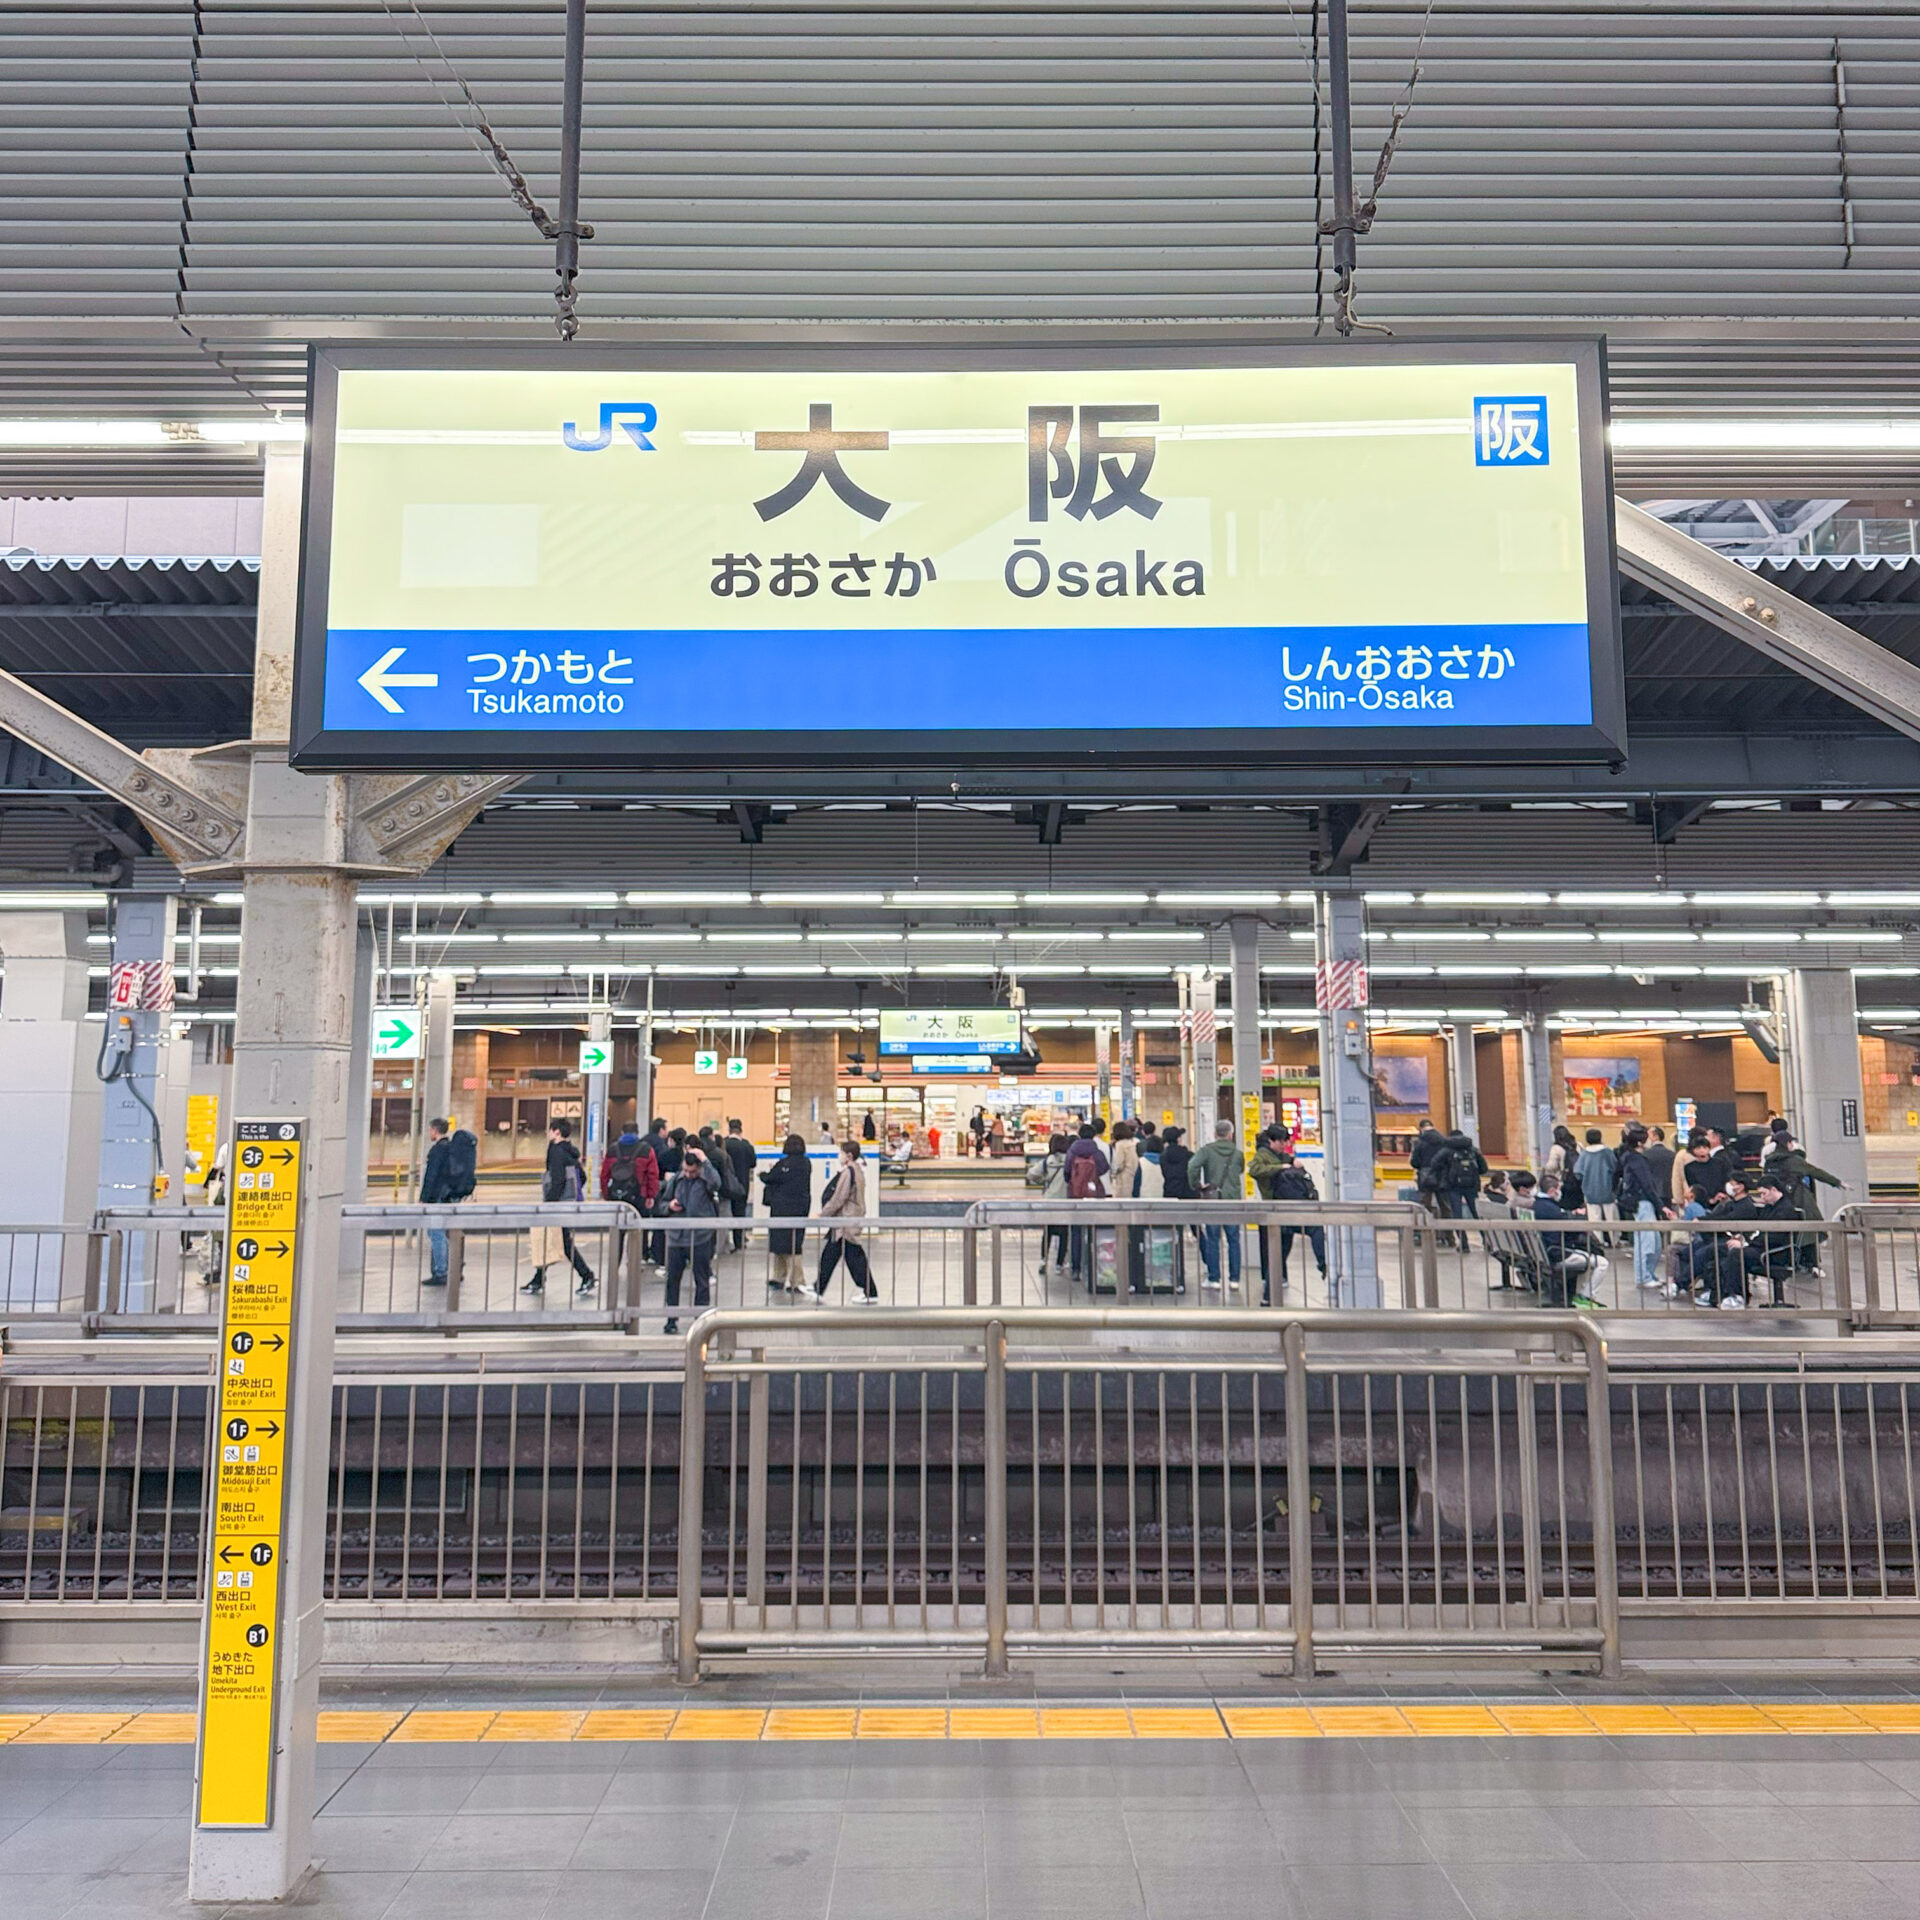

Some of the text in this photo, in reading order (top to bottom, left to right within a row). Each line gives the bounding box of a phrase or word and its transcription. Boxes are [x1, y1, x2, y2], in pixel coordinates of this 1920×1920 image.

[563, 401, 658, 451] JR
[1481, 402, 1543, 461] 阪
[710, 539, 1206, 598] おおさか Ōsaka
[466, 650, 635, 686] つかもと
[1282, 645, 1516, 681] しんおおさか
[1283, 679, 1454, 711] Shin-Ōsaka
[466, 690, 624, 715] Tsukamoto
[241, 1125, 268, 1133] ここは
[281, 1127, 293, 1137] 2F
[244, 1150, 262, 1165] 3F
[238, 1192, 292, 1202] 連絡橋出口
[237, 1203, 265, 1212] Bridge
[240, 1242, 257, 1257] 1F
[232, 1284, 278, 1294] 桜橋出口
[231, 1296, 288, 1304] Sakurabashi Exit
[234, 1336, 252, 1350] 1F
[227, 1378, 273, 1388] 中央出口
[226, 1390, 276, 1398] Central Exit
[230, 1422, 247, 1437] 1F
[223, 1465, 278, 1476] 御堂筋出口
[256, 1477, 271, 1485] Exit
[221, 1502, 255, 1512] 南出口
[220, 1514, 264, 1522] South Exit
[253, 1547, 271, 1561] 1F
[216, 1591, 251, 1601] 西出口
[215, 1603, 256, 1611] West Exit
[248, 1628, 266, 1643] B1
[213, 1652, 253, 1662] うめきた
[212, 1664, 255, 1675] 地下出口
[211, 1685, 252, 1694] Underground
